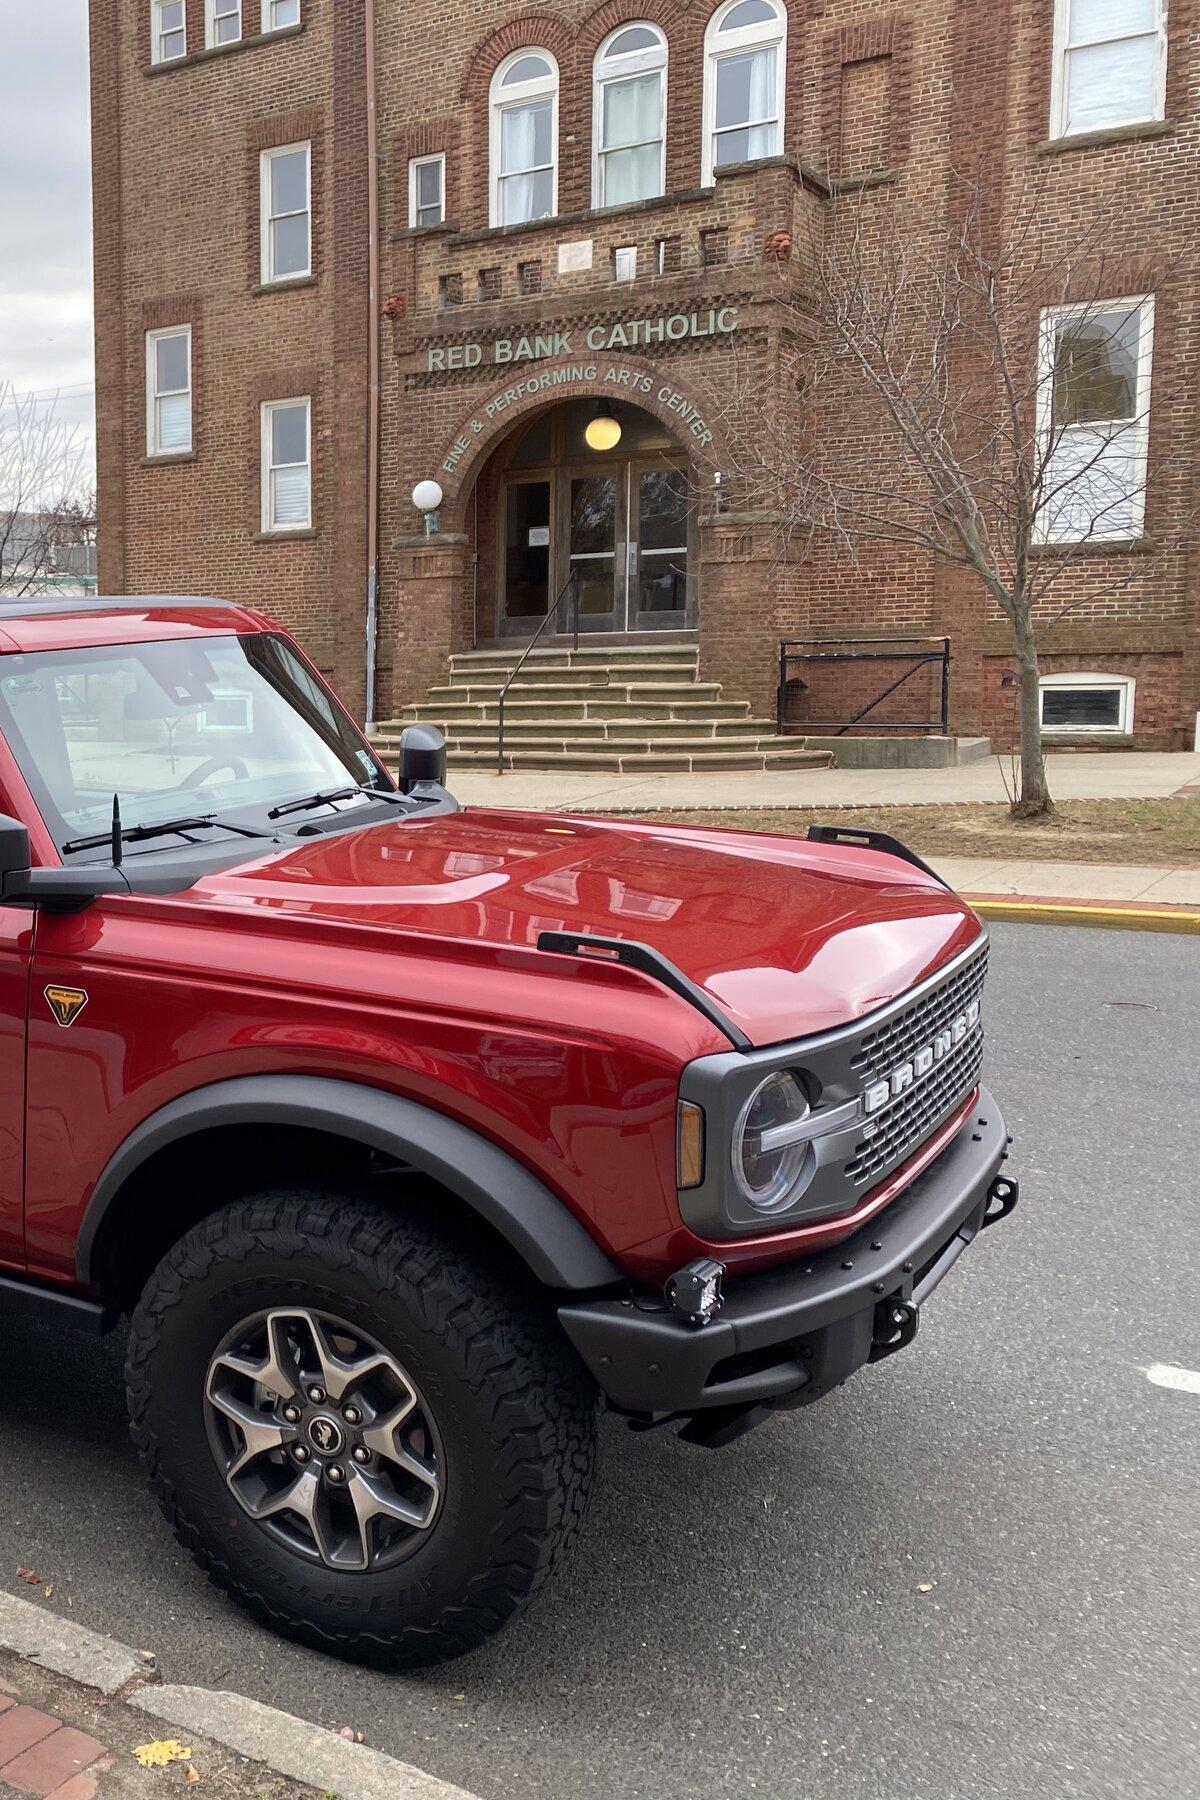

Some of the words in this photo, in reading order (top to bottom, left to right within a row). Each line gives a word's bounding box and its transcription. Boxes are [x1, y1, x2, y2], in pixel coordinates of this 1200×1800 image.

[428, 343, 483, 371] RED
[495, 331, 573, 364] BANK
[586, 307, 739, 351] CATHOLIC
[442, 435, 471, 473] FINE
[471, 419, 485, 433] &
[484, 366, 599, 419] PERFORMING
[604, 367, 654, 394] ARTS
[657, 387, 714, 448] CENTER
[865, 999, 980, 1112] BRONCO
